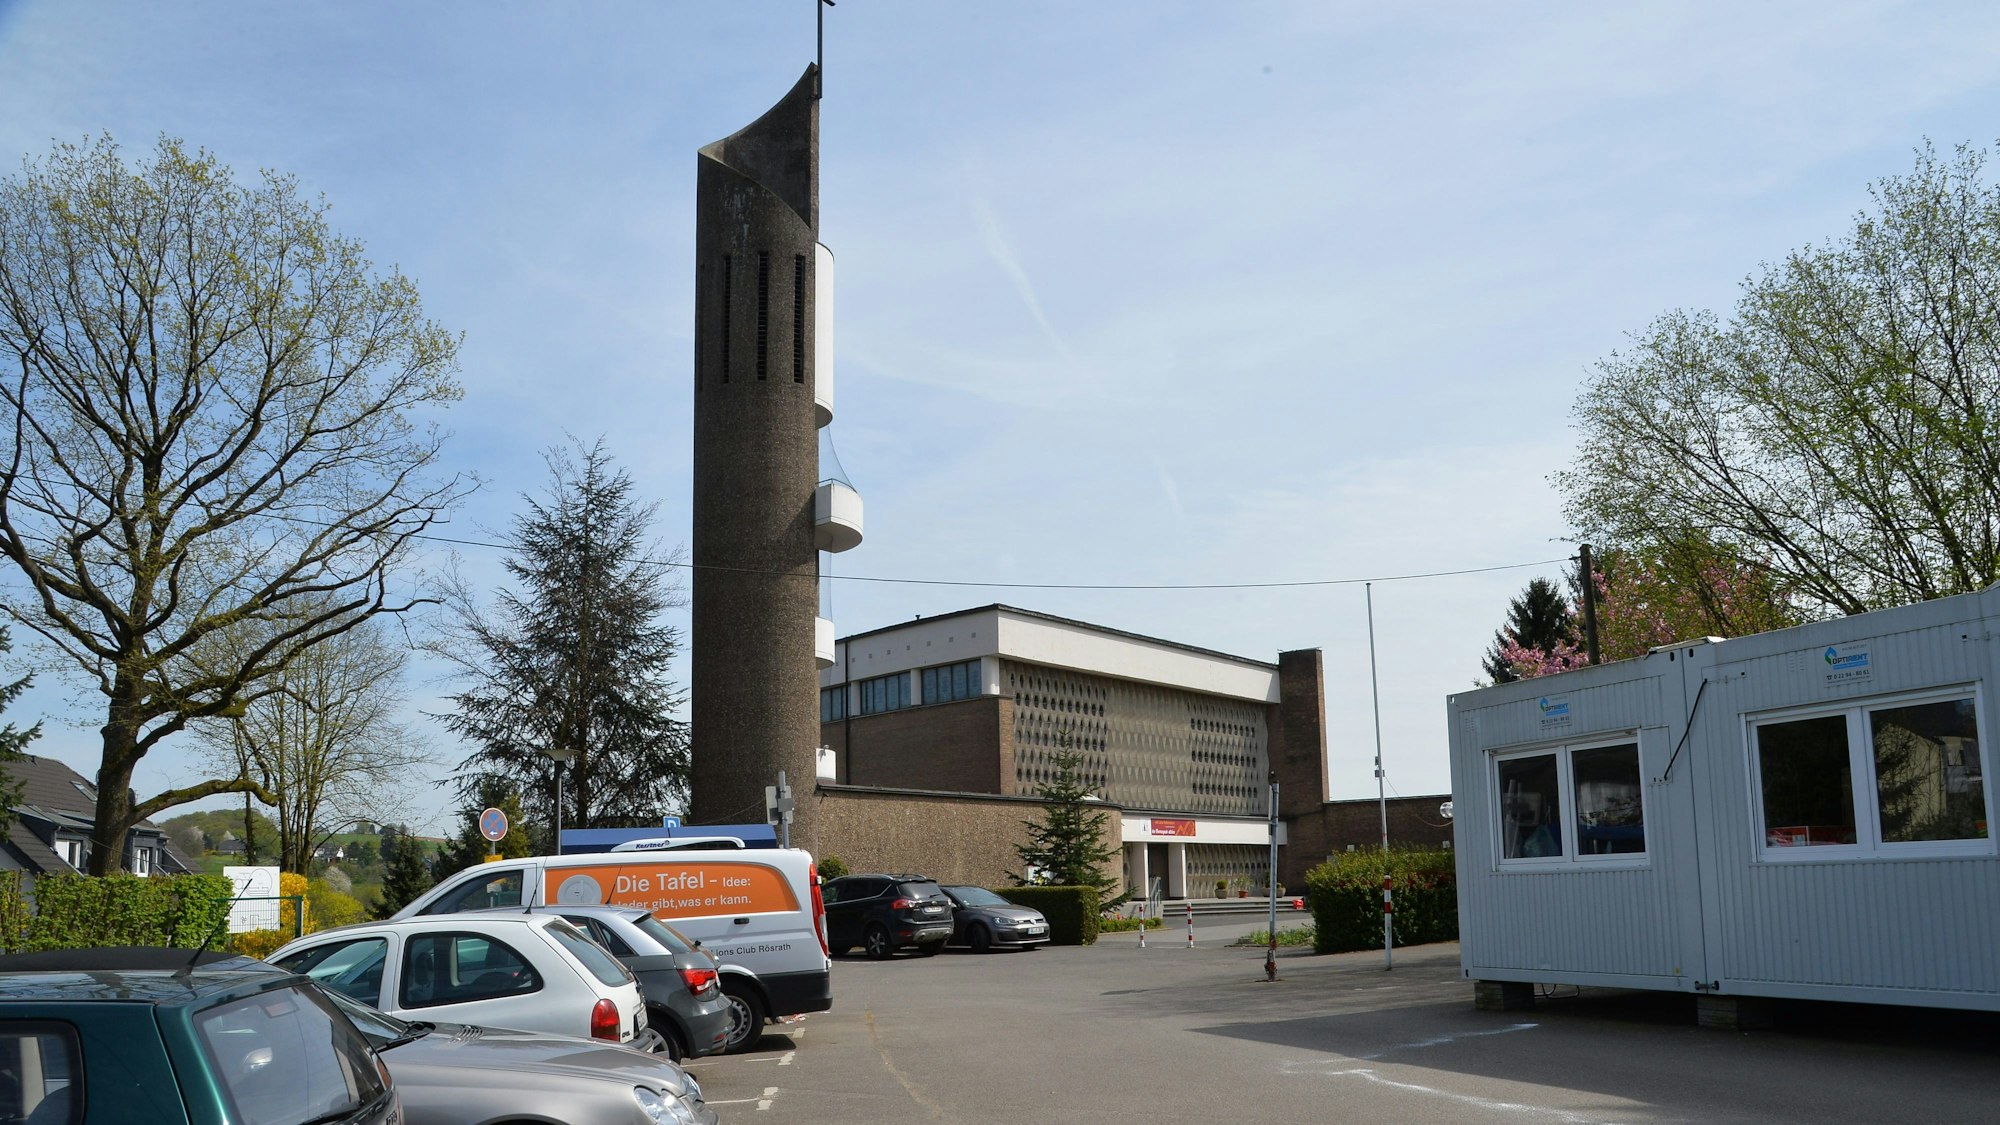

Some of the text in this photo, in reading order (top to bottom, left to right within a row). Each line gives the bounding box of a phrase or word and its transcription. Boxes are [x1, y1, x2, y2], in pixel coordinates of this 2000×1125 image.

[617, 875, 650, 893] Die
[656, 871, 704, 890] Tafel
[722, 876, 751, 887] Idee:
[705, 897, 716, 906] er
[720, 895, 752, 905] kann.
[711, 943, 791, 957] ions Club Rösrath
